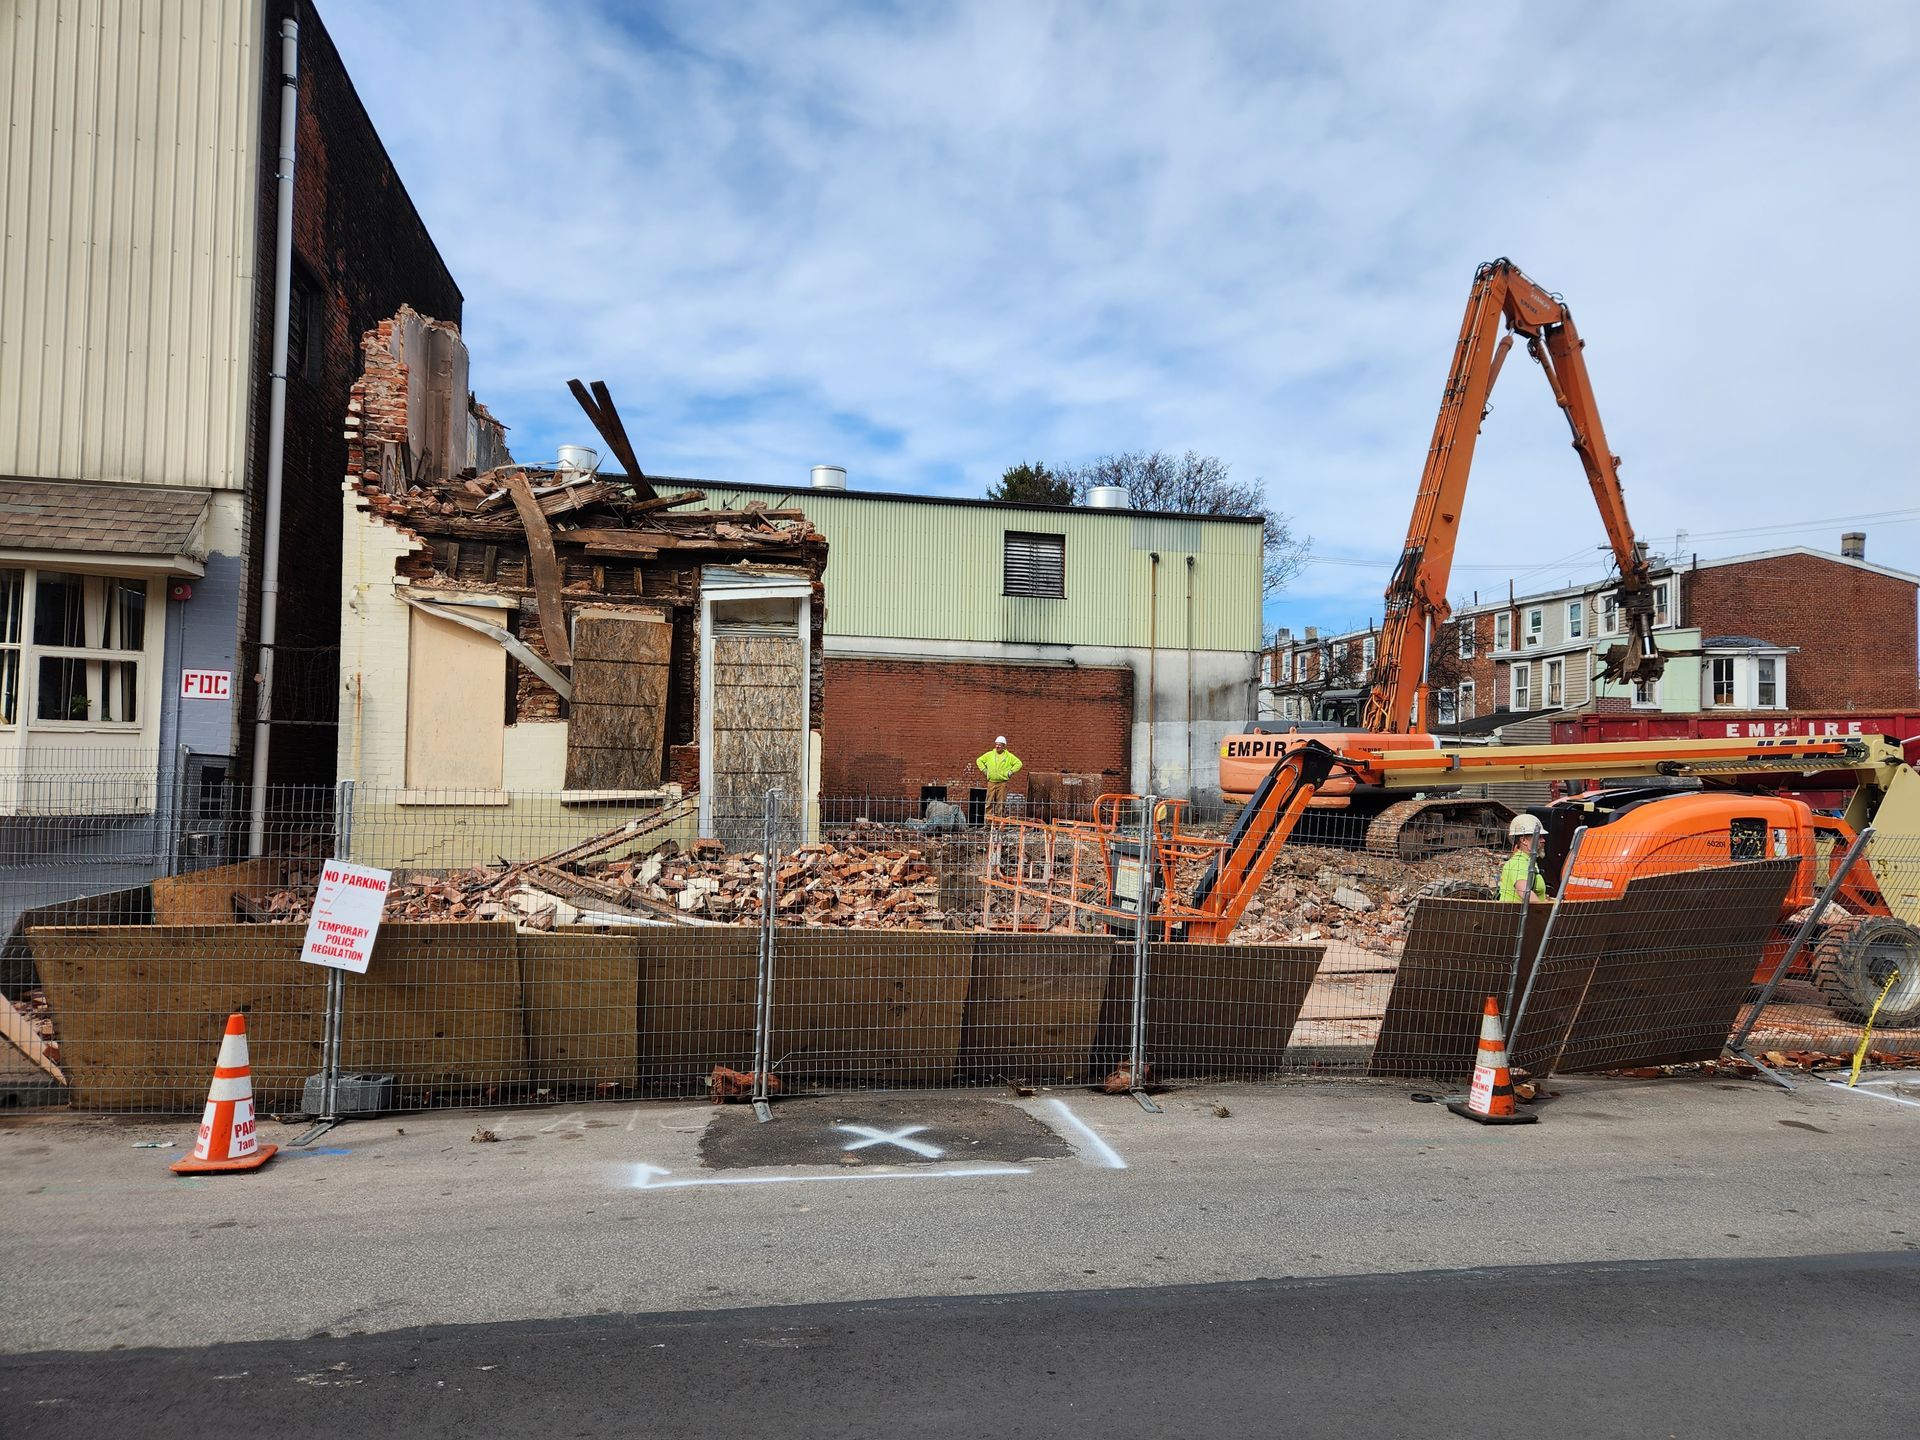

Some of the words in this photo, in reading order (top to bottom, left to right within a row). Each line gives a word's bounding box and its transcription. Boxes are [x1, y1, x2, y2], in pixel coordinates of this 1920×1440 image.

[184, 674, 228, 694] FDC
[1726, 721, 1862, 737] EMPIRE
[1227, 741, 1294, 757] EMPIR
[323, 870, 339, 882] NO
[341, 873, 387, 892] PARKING
[317, 920, 370, 939] TEMPORARY
[325, 934, 356, 948] POLICE
[311, 943, 363, 961] REGULATION
